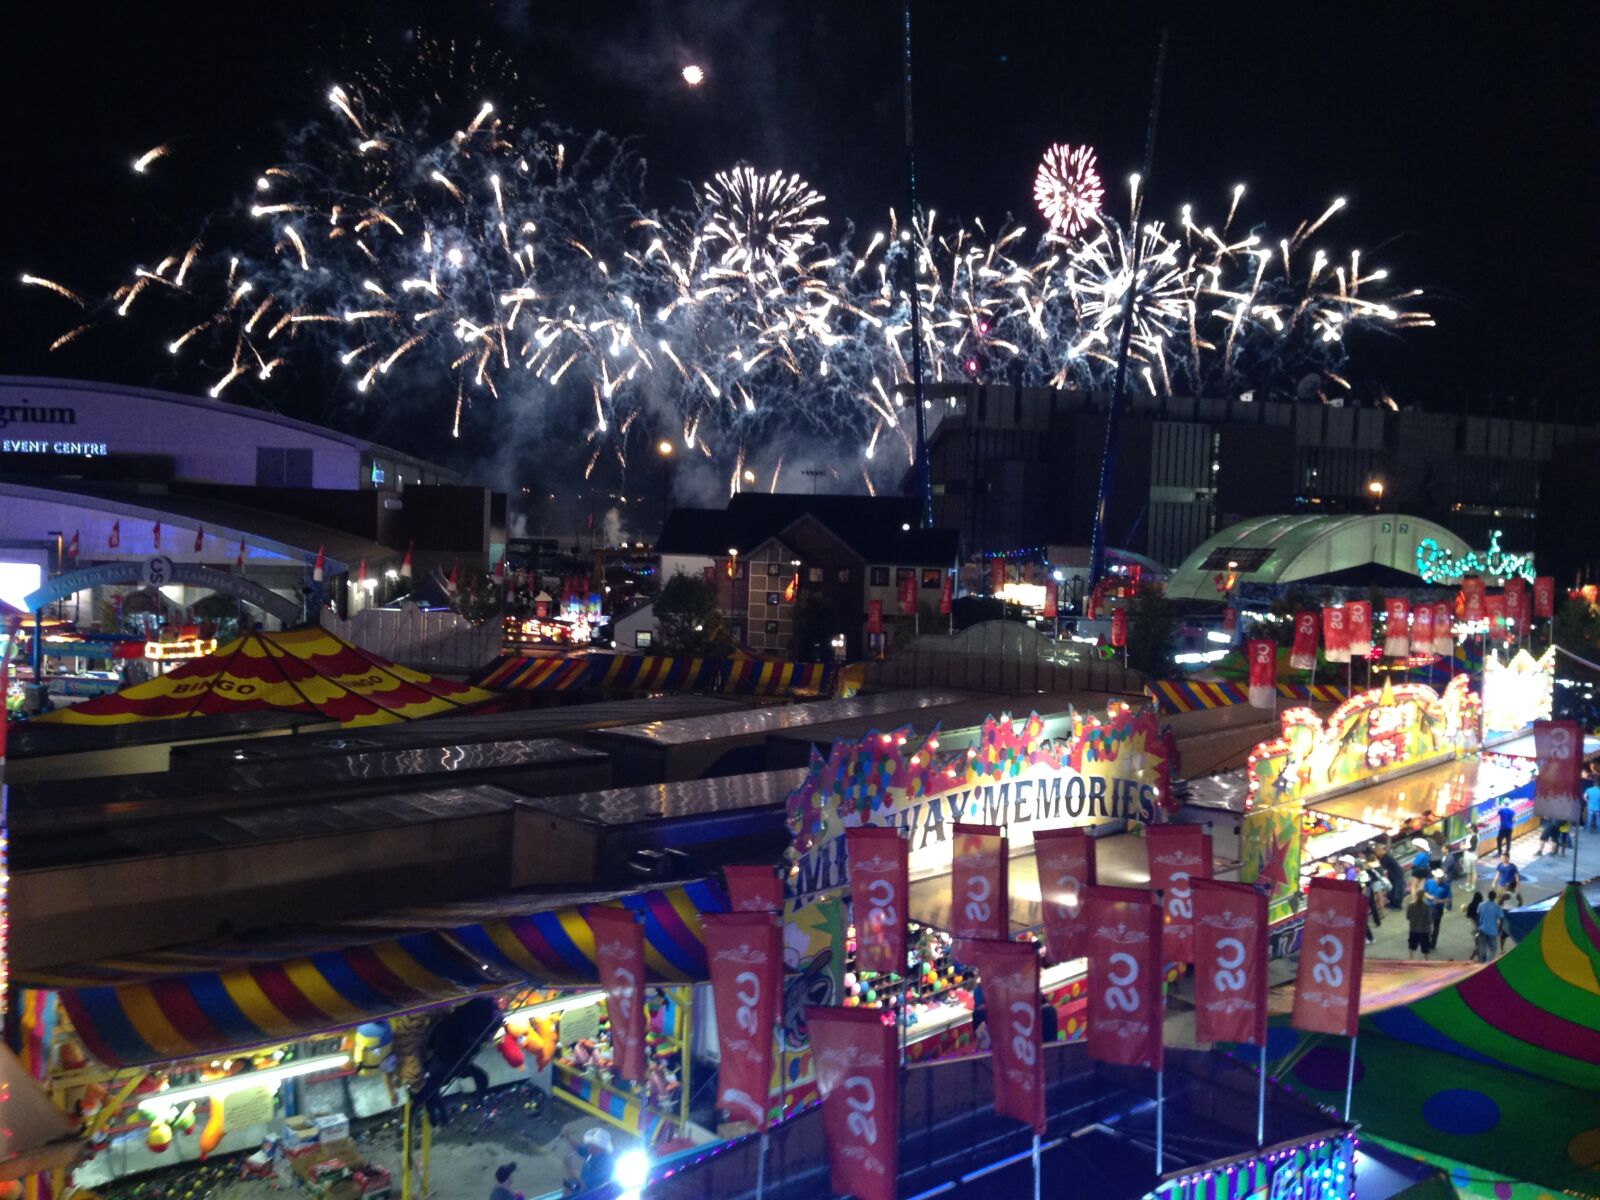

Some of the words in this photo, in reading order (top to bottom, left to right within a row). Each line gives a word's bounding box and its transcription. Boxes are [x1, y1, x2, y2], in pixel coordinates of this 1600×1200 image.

[2, 439, 49, 453] EVENT
[53, 441, 108, 456] CENTRE
[171, 679, 256, 694] BINGO
[792, 790, 972, 912] MIWAY
[982, 776, 1155, 825] MEMORIES
